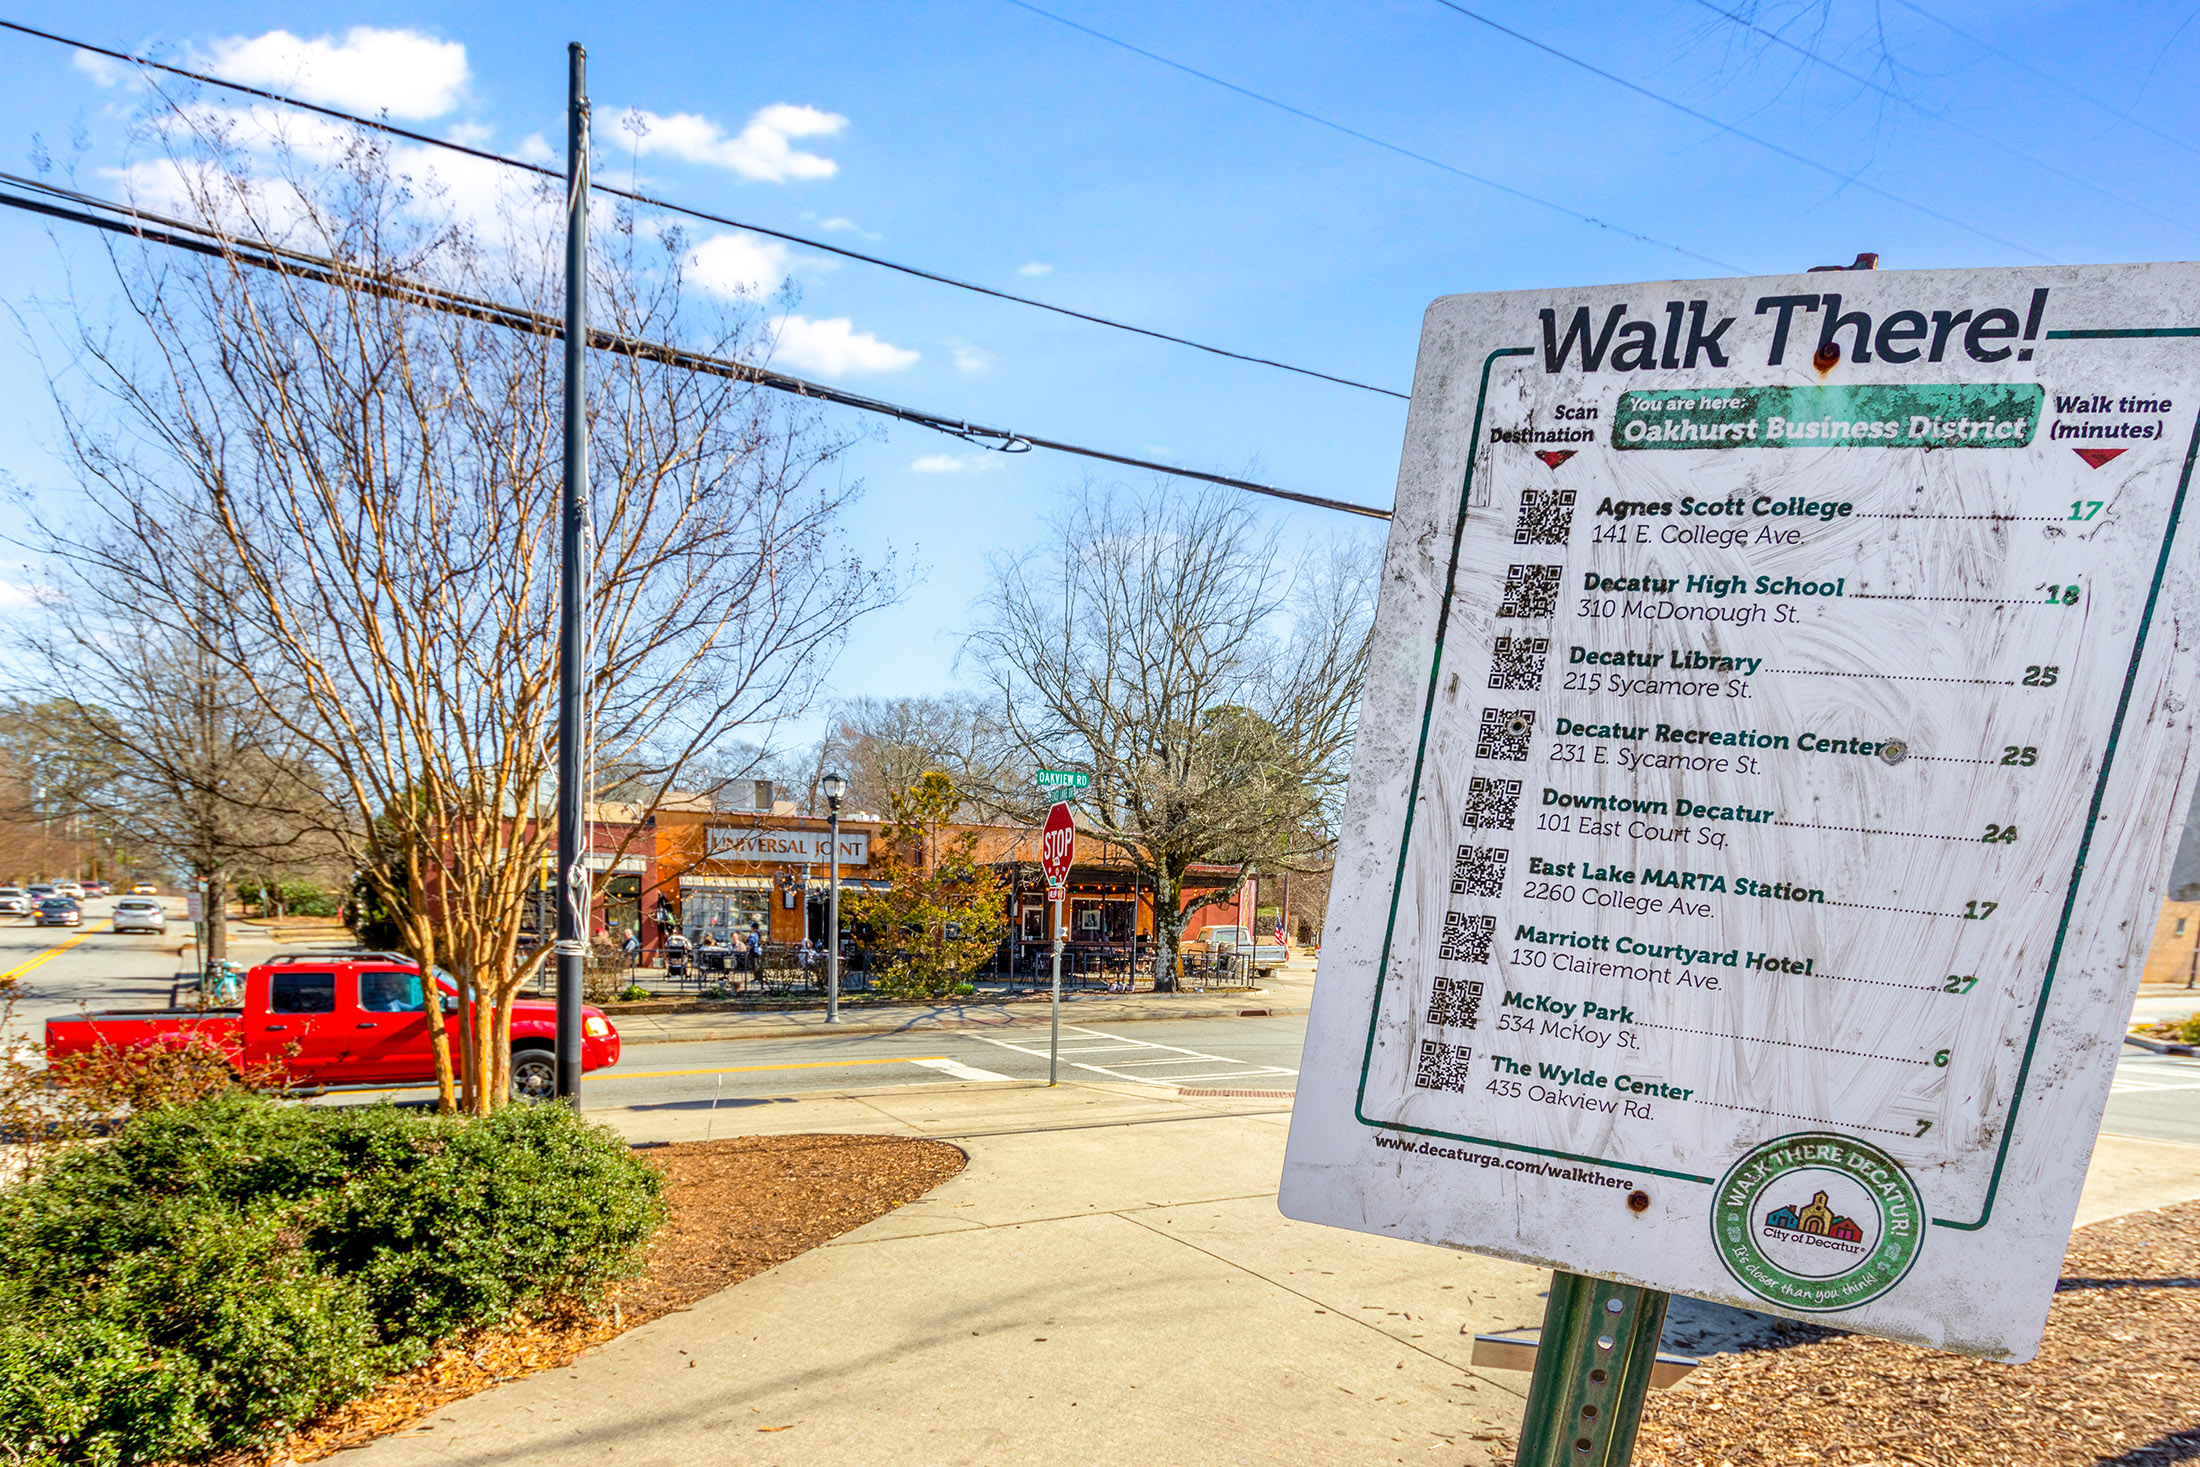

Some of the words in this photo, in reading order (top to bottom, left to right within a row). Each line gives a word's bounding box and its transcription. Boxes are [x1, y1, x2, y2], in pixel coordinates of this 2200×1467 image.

[1538, 300, 1737, 373] Walk
[1754, 288, 2050, 366] There!
[1554, 405, 1598, 420] Scan
[1629, 397, 1663, 412] You
[1666, 398, 1695, 411] are
[1699, 395, 1748, 410] here:
[2056, 396, 2113, 413] Walk
[2119, 396, 2172, 413] time
[1490, 427, 1595, 444] Destination
[1624, 417, 1758, 443] Oakhurst
[1765, 416, 1899, 441] Business
[1908, 415, 2027, 440] District
[2050, 420, 2164, 441] (minutes)
[1596, 497, 1672, 521] Agnes
[1679, 497, 1746, 516] Scott
[1752, 497, 1853, 521] College
[2067, 501, 2104, 522] 17
[1592, 525, 1628, 543] 141
[1635, 525, 1652, 543] E.
[1661, 525, 1748, 548] College
[1755, 525, 1805, 545] Ave.
[1584, 572, 1679, 593] Decatur
[1686, 575, 1747, 598] High
[1754, 576, 1845, 597] School
[2045, 585, 2080, 606] 18
[1577, 599, 1615, 618] 310
[1621, 600, 1766, 626] McDonough
[1774, 603, 1800, 624] St.
[1569, 646, 1663, 667] Decatur
[1670, 650, 1762, 676] Library
[2022, 665, 2059, 687] 25
[1563, 672, 1601, 691] 215
[1607, 673, 1720, 697] Sycamore
[1726, 679, 1752, 699] St.
[1550, 743, 1586, 763] 231
[1593, 745, 1609, 764] E.
[1617, 747, 1729, 773] Sycamore
[1735, 755, 1761, 775] St.
[1556, 718, 1648, 742] Decatur
[1655, 724, 1790, 751] Recreation
[1797, 732, 1886, 757] Center
[2001, 746, 2038, 767] 25
[1039, 772, 1074, 786] OAKVIEW
[1076, 775, 1087, 786] RD
[1537, 813, 1571, 832] 101
[1578, 816, 1622, 837] East
[1628, 821, 1690, 844] Court
[1697, 827, 1728, 850] Sq.
[1542, 787, 1667, 816] Downtown
[1676, 798, 1774, 825] Decatur
[1982, 823, 2017, 844] 24
[713, 836, 807, 855] UNIVERSAL
[814, 840, 862, 857] JONT
[1044, 827, 1072, 860] STOP
[1523, 881, 1576, 903] 2260
[1582, 887, 1663, 915] College
[1668, 897, 1714, 918] Ave.
[1529, 857, 1576, 878] East
[1582, 862, 1635, 884] Lake
[1641, 868, 1727, 894] MARTA
[1734, 877, 1825, 903] Station
[1963, 900, 1998, 920] 17
[1510, 948, 1547, 968] 130
[1552, 953, 1670, 985] Clairemont
[1676, 970, 1722, 991] Ave.
[1514, 924, 1610, 951] Marriott
[1615, 937, 1738, 968] Courtyard
[1745, 952, 1814, 977] Hotel
[1943, 975, 1978, 994] 27
[1498, 1014, 1535, 1034] 534
[1540, 1019, 1612, 1049] McKoy
[1616, 1030, 1641, 1050] St.
[1501, 990, 1577, 1018] McKoy
[1582, 1001, 1635, 1025] Park
[1933, 1048, 1950, 1068] 6
[1486, 1079, 1522, 1099] 435
[1528, 1084, 1618, 1113] Oakview
[1624, 1100, 1655, 1121] Rd.
[1491, 1055, 1533, 1077] The
[1539, 1061, 1608, 1089] Wylde
[1614, 1074, 1694, 1102] Center
[1914, 1120, 1933, 1138] 7
[1375, 1135, 1634, 1191] www.decaturga.com/walkthere
[1727, 1160, 1773, 1208] WALK
[1769, 1144, 1844, 1167] THERE
[1846, 1151, 1910, 1238] DECATUR!
[1763, 1227, 1788, 1244] City
[1791, 1230, 1804, 1244] of
[1805, 1232, 1860, 1254] Decatur
[1732, 1244, 1750, 1264] It's
[1745, 1263, 1780, 1289] closer
[1781, 1283, 1812, 1301] than
[1815, 1290, 1840, 1303] you
[1842, 1273, 1878, 1294] think!
